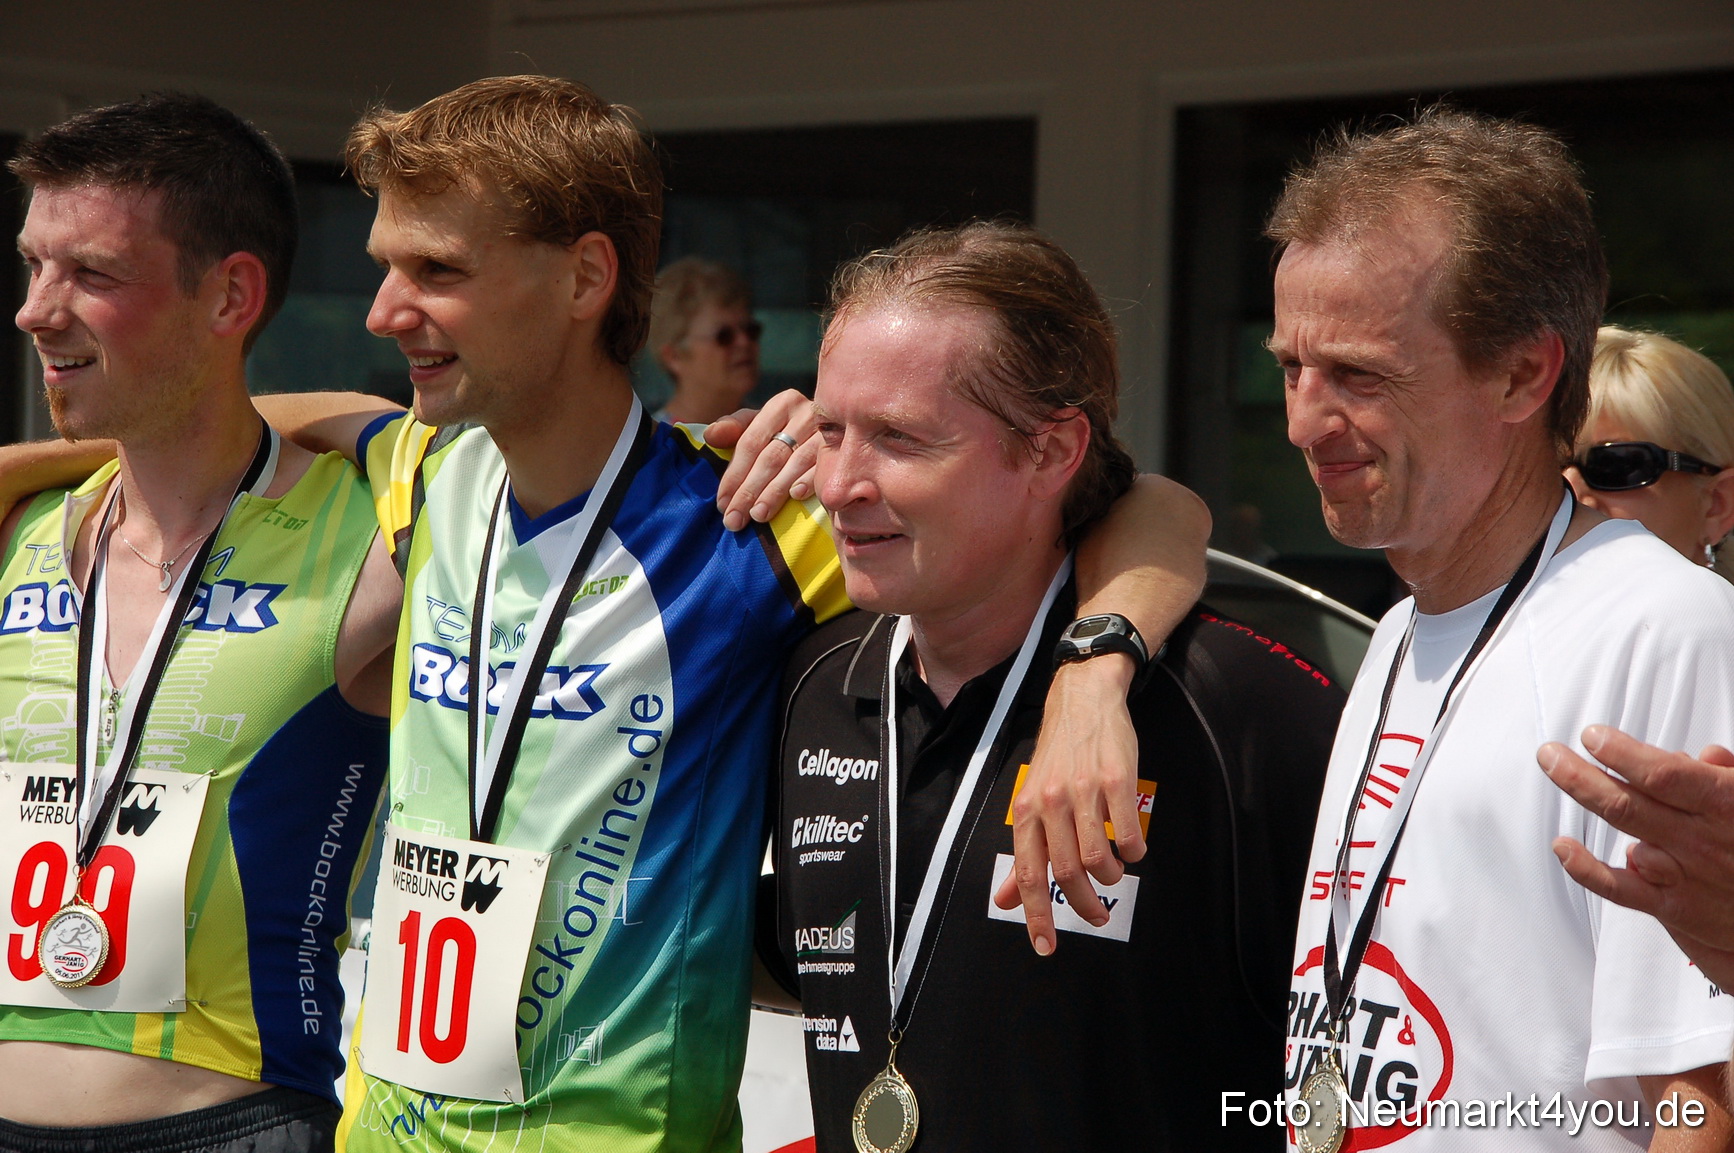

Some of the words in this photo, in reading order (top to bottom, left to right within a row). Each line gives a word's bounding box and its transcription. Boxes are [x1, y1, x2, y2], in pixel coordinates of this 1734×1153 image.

[797, 748, 879, 786] Cellagon
[21, 776, 77, 803] MEY
[20, 804, 77, 825] WERBU
[393, 838, 459, 880] MEYER
[799, 849, 846, 866] sportswear
[297, 763, 365, 1035] www.bockonline.de
[392, 867, 456, 902] WERBUNG
[397, 909, 477, 1065] 10
[815, 1033, 837, 1051] data
[1397, 1014, 1416, 1046] &
